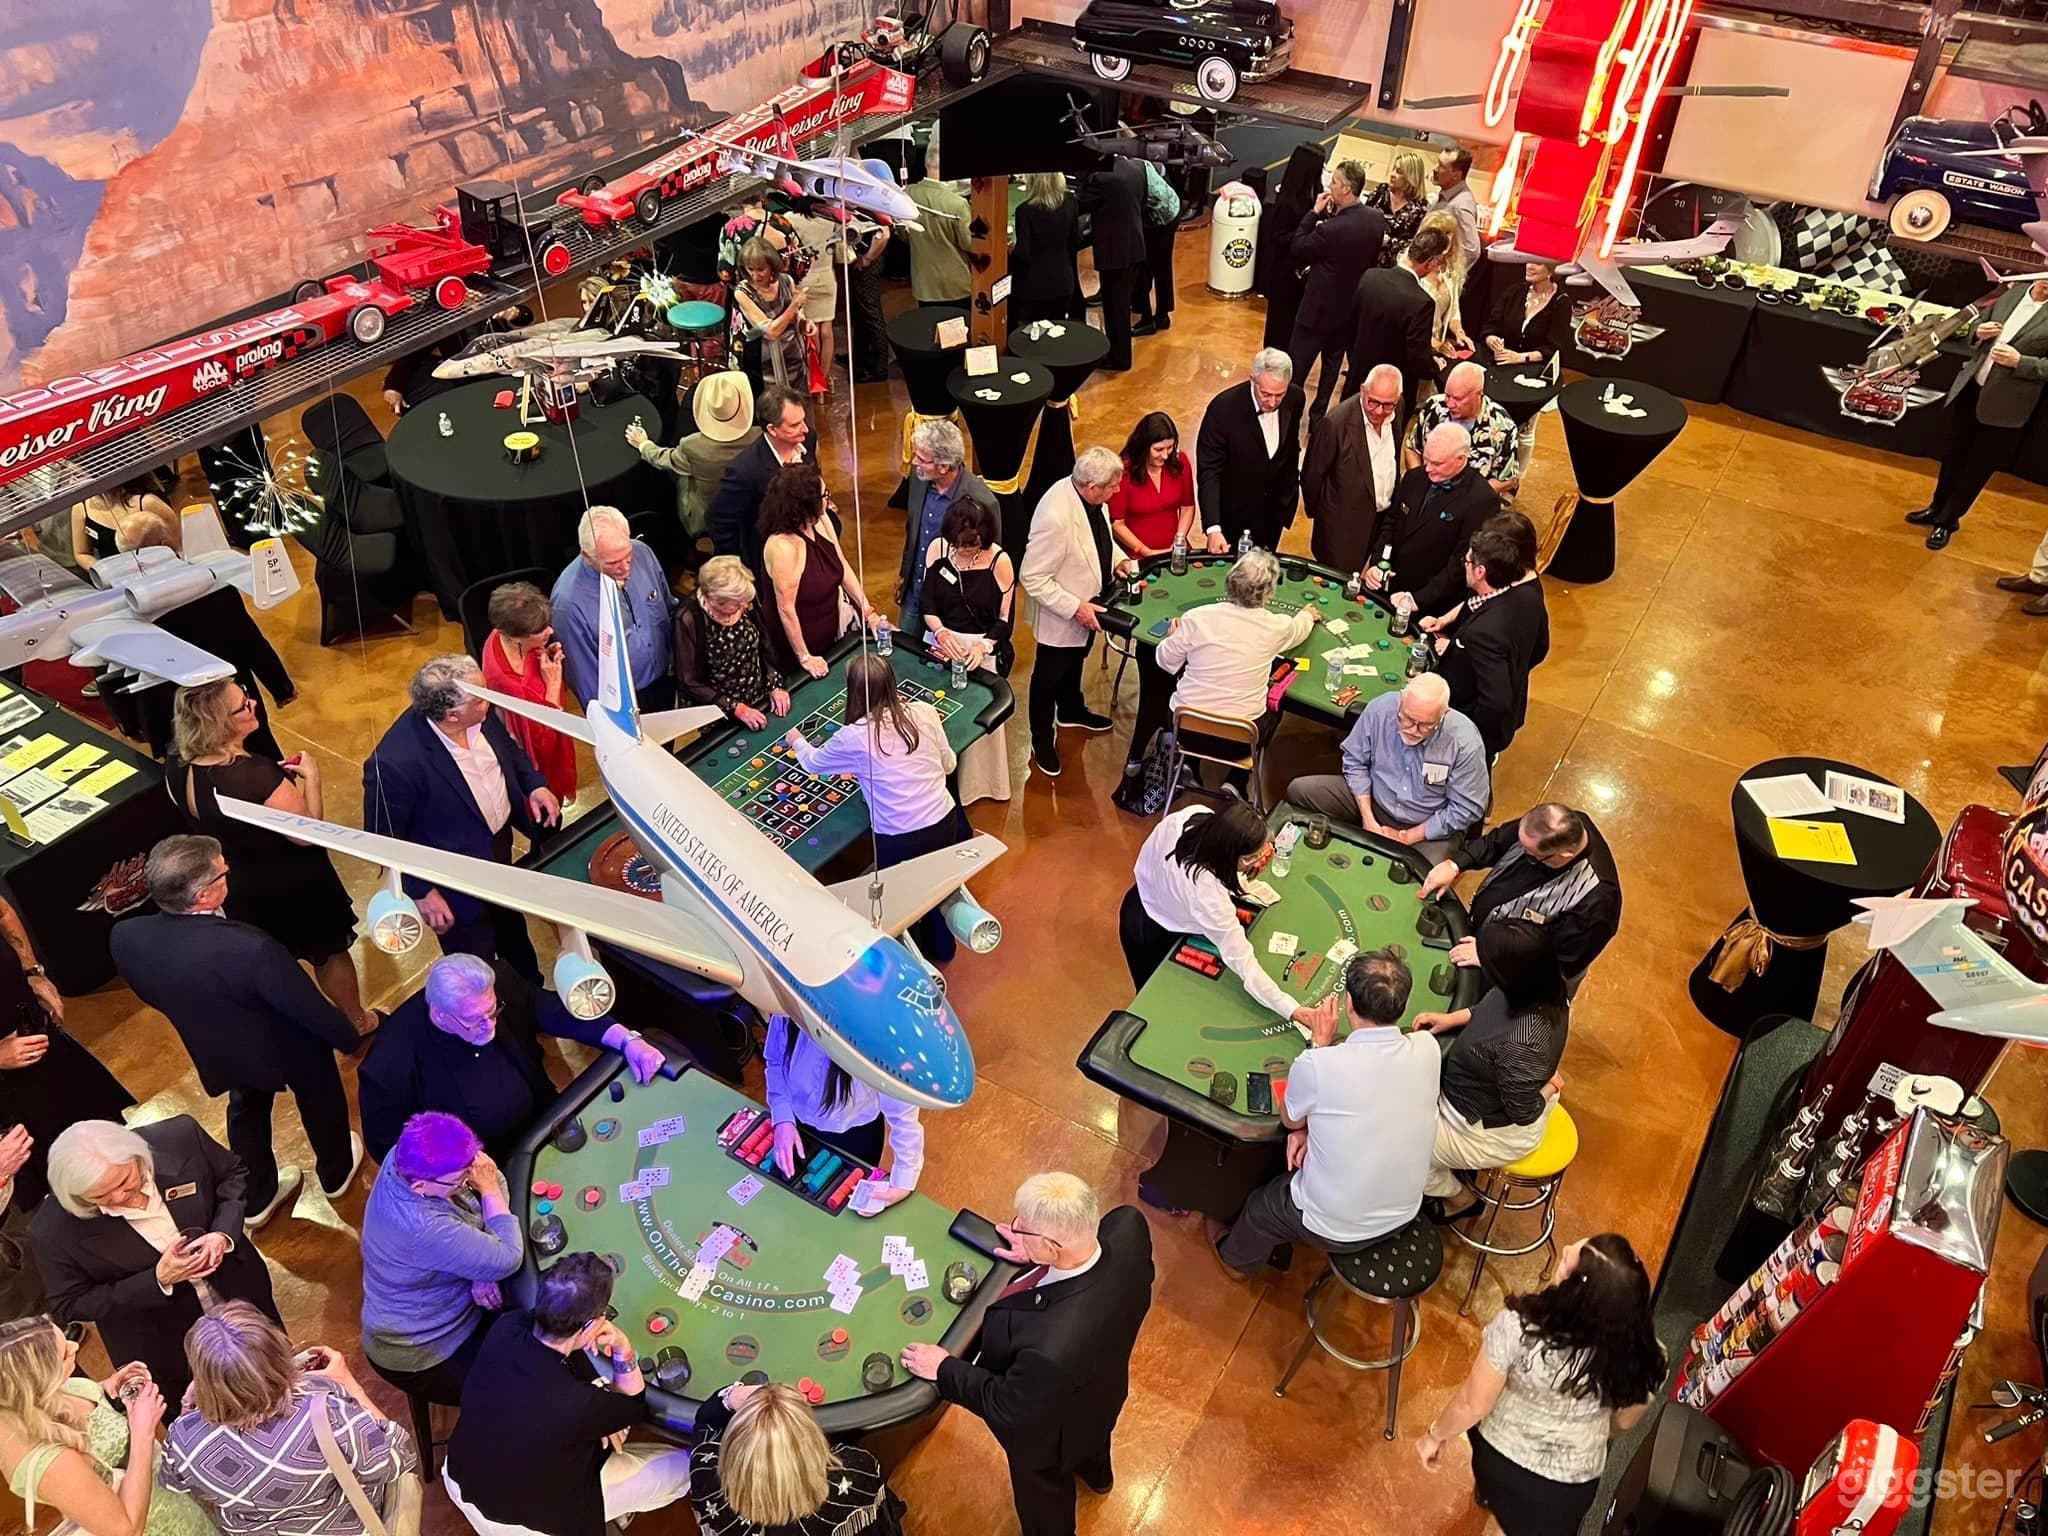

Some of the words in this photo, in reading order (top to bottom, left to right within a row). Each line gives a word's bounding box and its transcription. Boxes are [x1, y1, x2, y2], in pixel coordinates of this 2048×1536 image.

[236, 339, 282, 373] prolong
[192, 360, 228, 386] MAC
[194, 374, 229, 393] TOOLS
[88, 384, 168, 434] King
[267, 558, 279, 569] SP
[787, 771, 803, 781] 10
[807, 781, 822, 792] 11
[838, 781, 855, 792] 15
[794, 792, 808, 802] 8
[780, 804, 796, 814] 5
[765, 815, 780, 826] 2
[785, 825, 800, 836] 3
[651, 802, 690, 846] UNITED
[684, 835, 728, 883] STATES
[722, 873, 745, 897] OF
[735, 889, 795, 953] AMERICA
[2009, 857, 2048, 920] CAS
[718, 1271, 735, 1284] On
